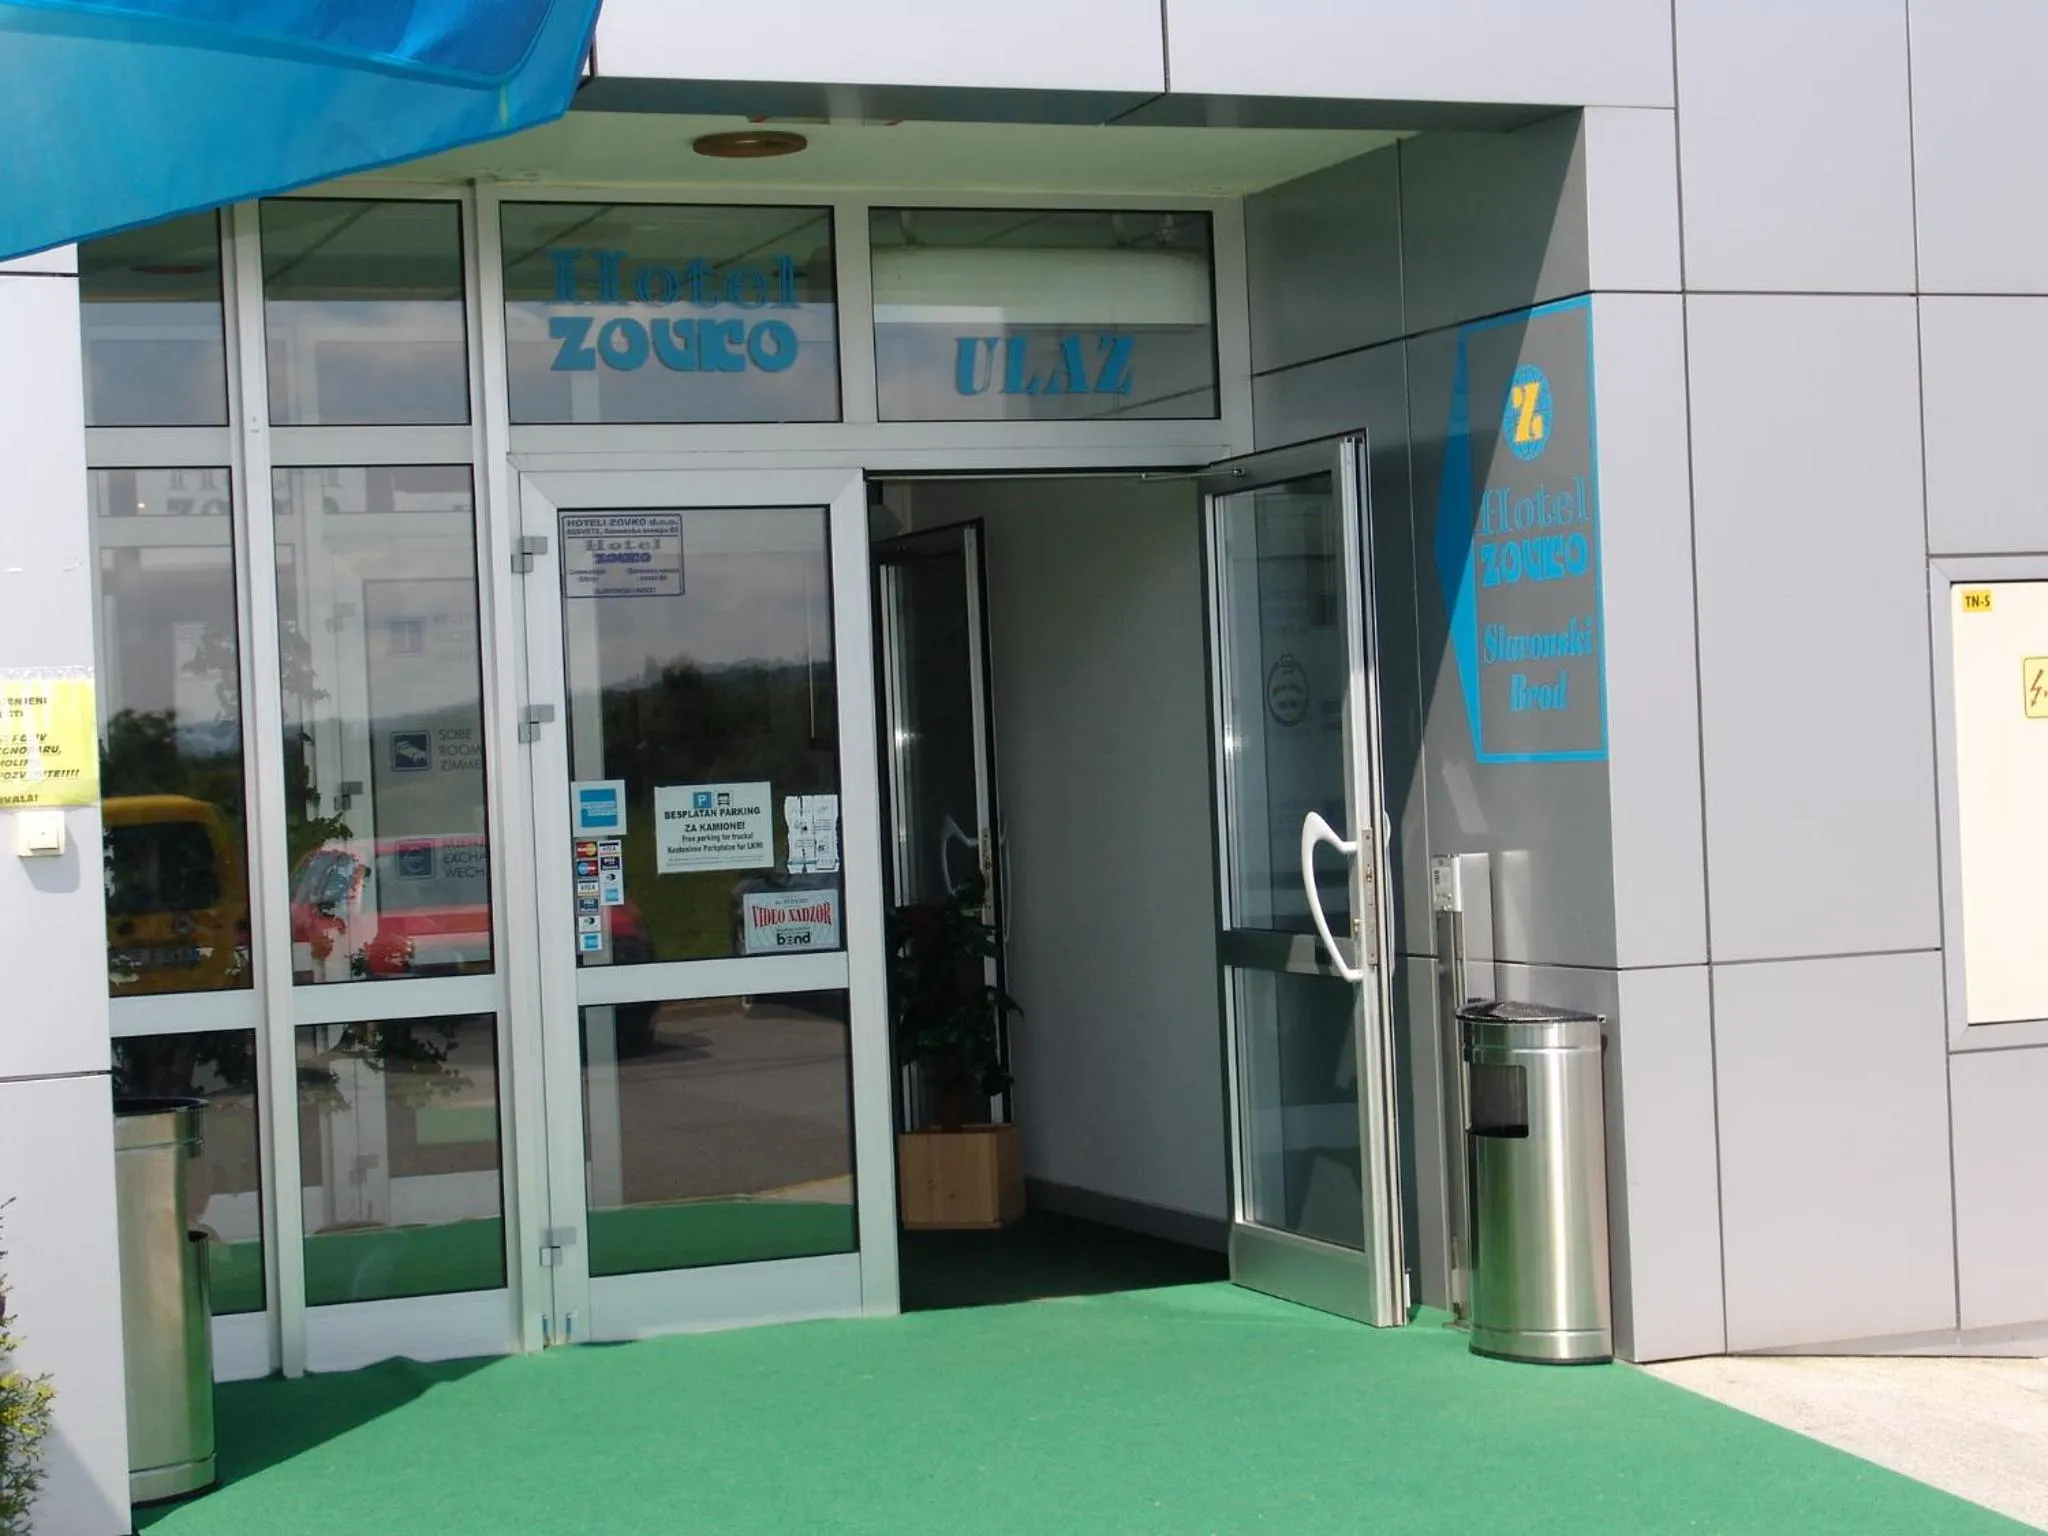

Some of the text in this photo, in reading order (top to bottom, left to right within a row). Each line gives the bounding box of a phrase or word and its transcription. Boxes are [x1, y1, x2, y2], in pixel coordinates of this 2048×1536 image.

[546, 247, 801, 309] Hotel
[953, 334, 1136, 396] ULAZ
[1478, 475, 1592, 537] Hotel
[567, 518, 606, 528] HOTELI
[610, 518, 647, 527] ZOVKO
[1965, 594, 1991, 608] TN-S
[1484, 615, 1593, 666] Slavonski
[1510, 670, 1568, 712] Brod
[438, 728, 472, 740] SOBE
[665, 806, 761, 820] BESPLATAN PARKING
[684, 824, 698, 833] ZA
[698, 833, 721, 843] parking
[752, 905, 785, 930] VIDEO
